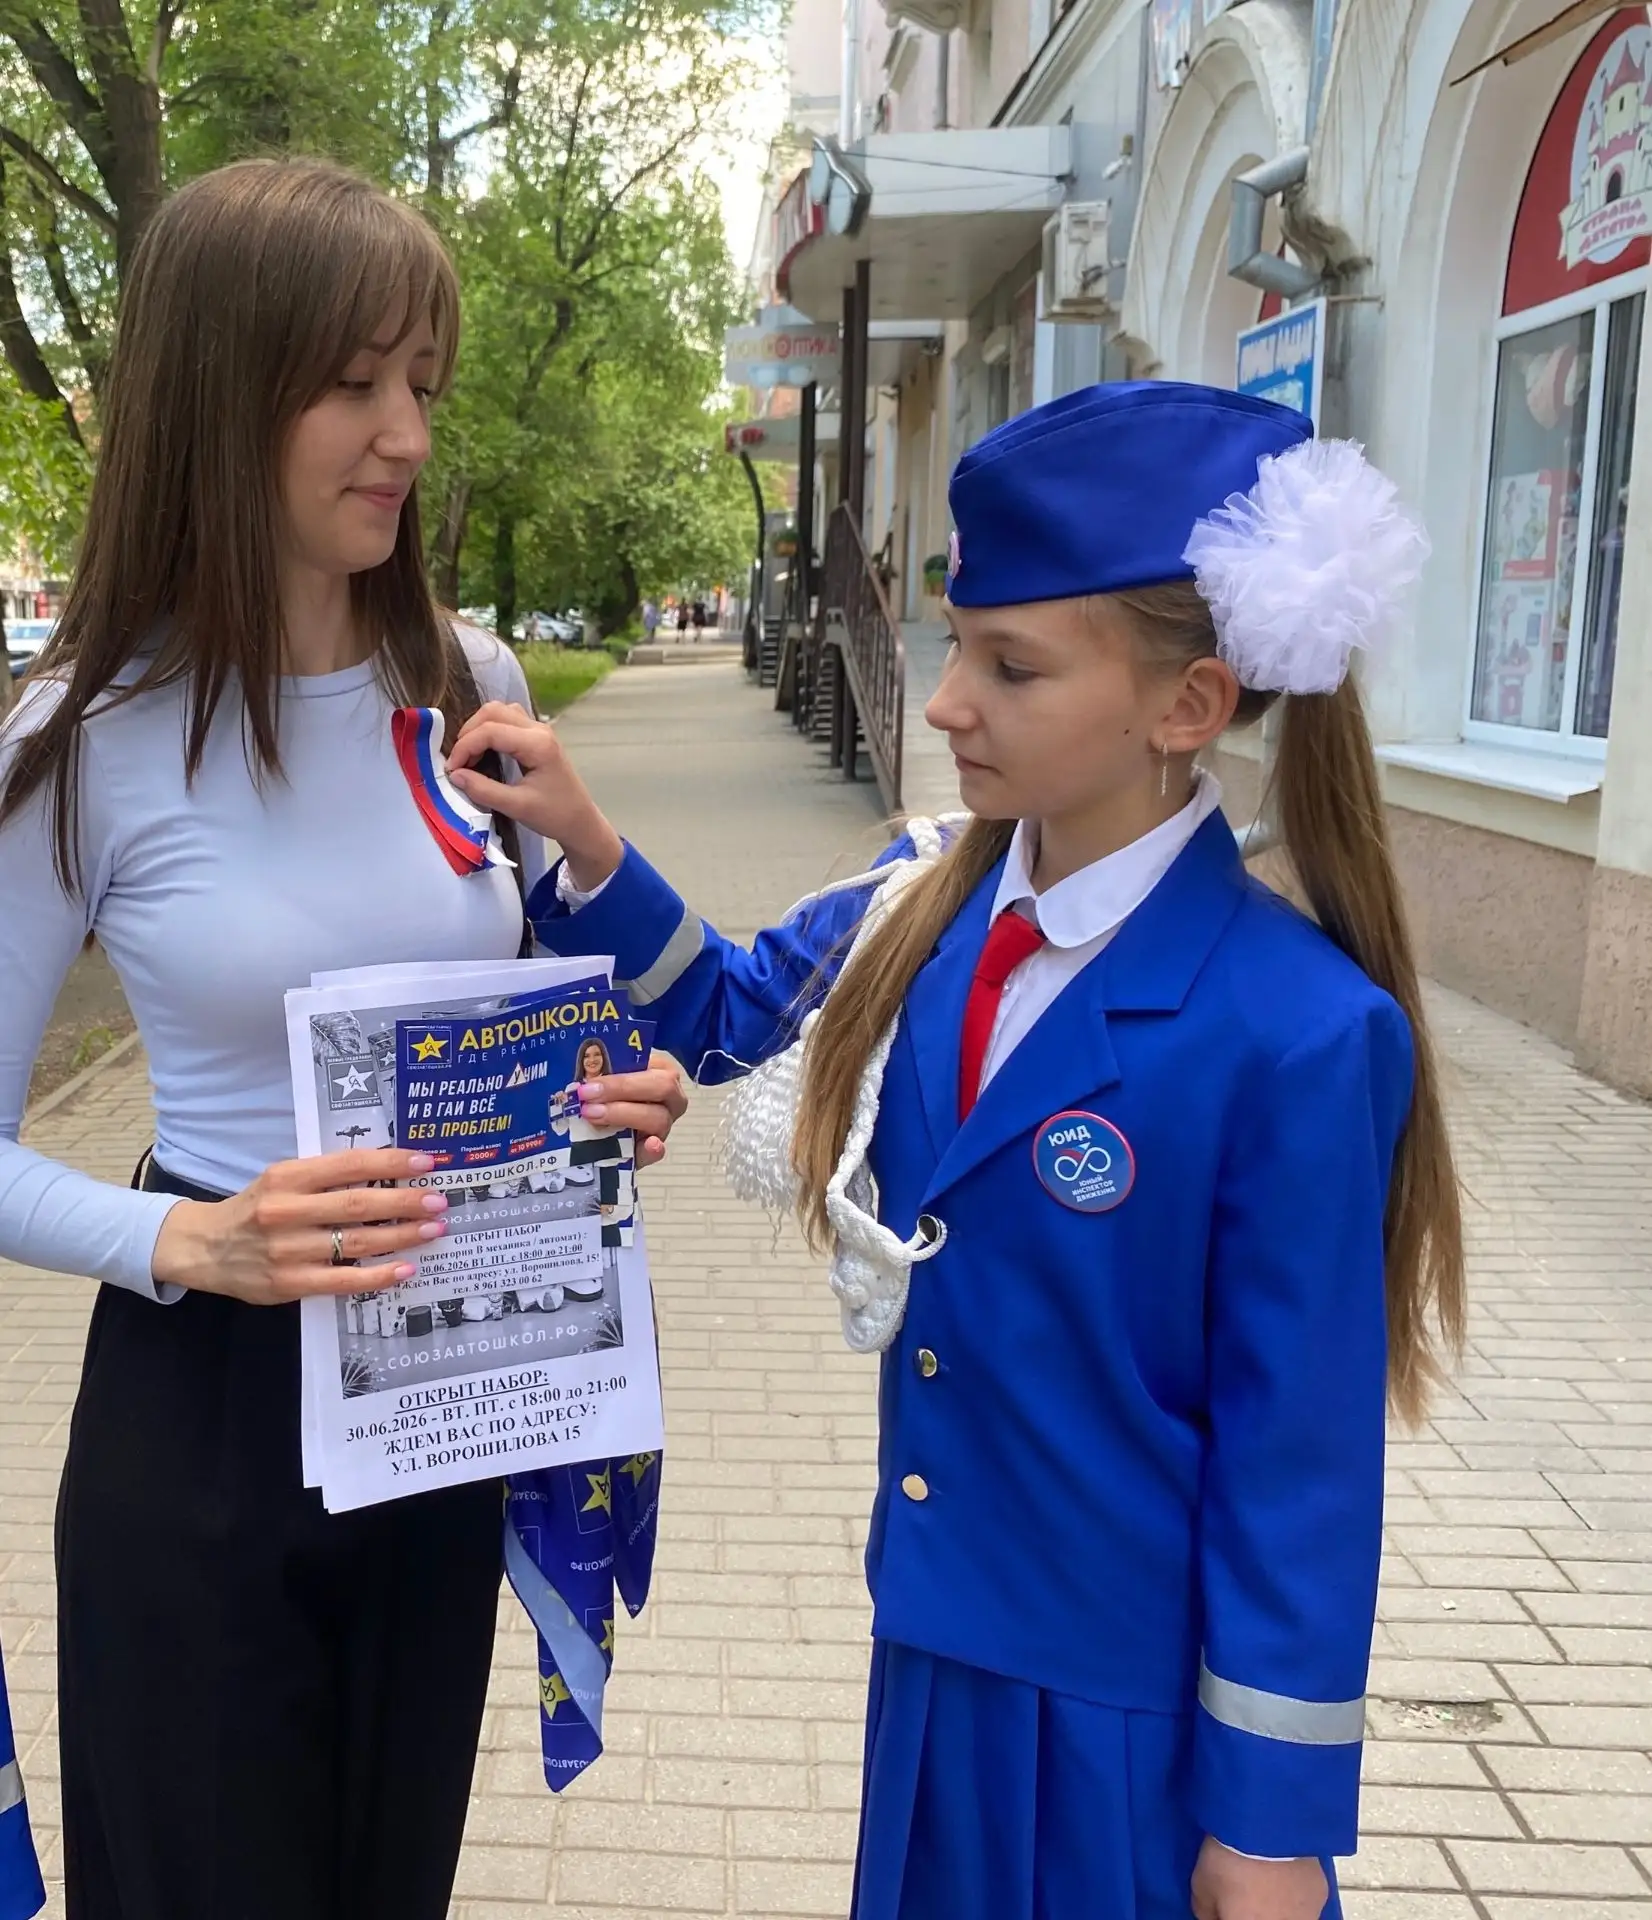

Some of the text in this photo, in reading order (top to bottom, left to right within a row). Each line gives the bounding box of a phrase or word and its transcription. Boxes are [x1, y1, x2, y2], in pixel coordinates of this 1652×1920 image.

[459, 1000, 619, 1050] АВТОШКОЛА
[458, 1023, 620, 1064] ГДЕ РЕАЛЬНО УЧАТ
[408, 1082, 433, 1098] МЫ
[439, 1075, 503, 1096] РЕАЛЬНО
[408, 1094, 496, 1118] И В ГАИ ВСЁ
[408, 1114, 512, 1139] БЕЗ ПРОБЛЕМ!
[1048, 1125, 1092, 1147] ЮИД
[409, 1156, 557, 1187] СОЮЗАВТОШКОЛ.РФ
[1079, 1174, 1103, 1187] ЮНЫЙ
[1071, 1180, 1114, 1197] ИНСПЕКТОР
[1076, 1187, 1117, 1202] ДВИЖЕНИЯ
[441, 1200, 575, 1224] ОЮЗАВТОШКОЛ.РФ
[454, 1224, 541, 1245] ОТКРЫТ НАБОР
[419, 1247, 473, 1263] (категория
[476, 1245, 483, 1254] В
[485, 1240, 531, 1253] механика
[420, 1261, 469, 1275] 30.06.2026
[519, 1248, 543, 1260] 18:00
[544, 1248, 556, 1258] до
[558, 1243, 583, 1254] 21:00
[433, 1274, 450, 1285] Вас
[452, 1273, 465, 1282] по
[473, 1281, 479, 1291] 8
[482, 1278, 497, 1290] 961
[500, 1277, 517, 1287] 323
[519, 1275, 529, 1285] 00
[531, 1273, 542, 1283] 62
[387, 1324, 579, 1370] СОЮЗАВТОШКОЛ.РФ
[399, 1369, 549, 1409] ОТКРЫТ НАБОР:
[346, 1411, 427, 1442] 30.06.2026
[442, 1405, 470, 1422] ВТ.
[474, 1399, 504, 1417] ПТ.
[508, 1398, 516, 1410] с
[521, 1388, 561, 1407] 18:00
[565, 1385, 582, 1401] до
[587, 1375, 627, 1395] 21:00
[384, 1403, 597, 1456] ЖДЕМ ВАС ПО АДРЕСУ:
[391, 1425, 581, 1476] УЛ. ВОРОШИЛОВА 15
